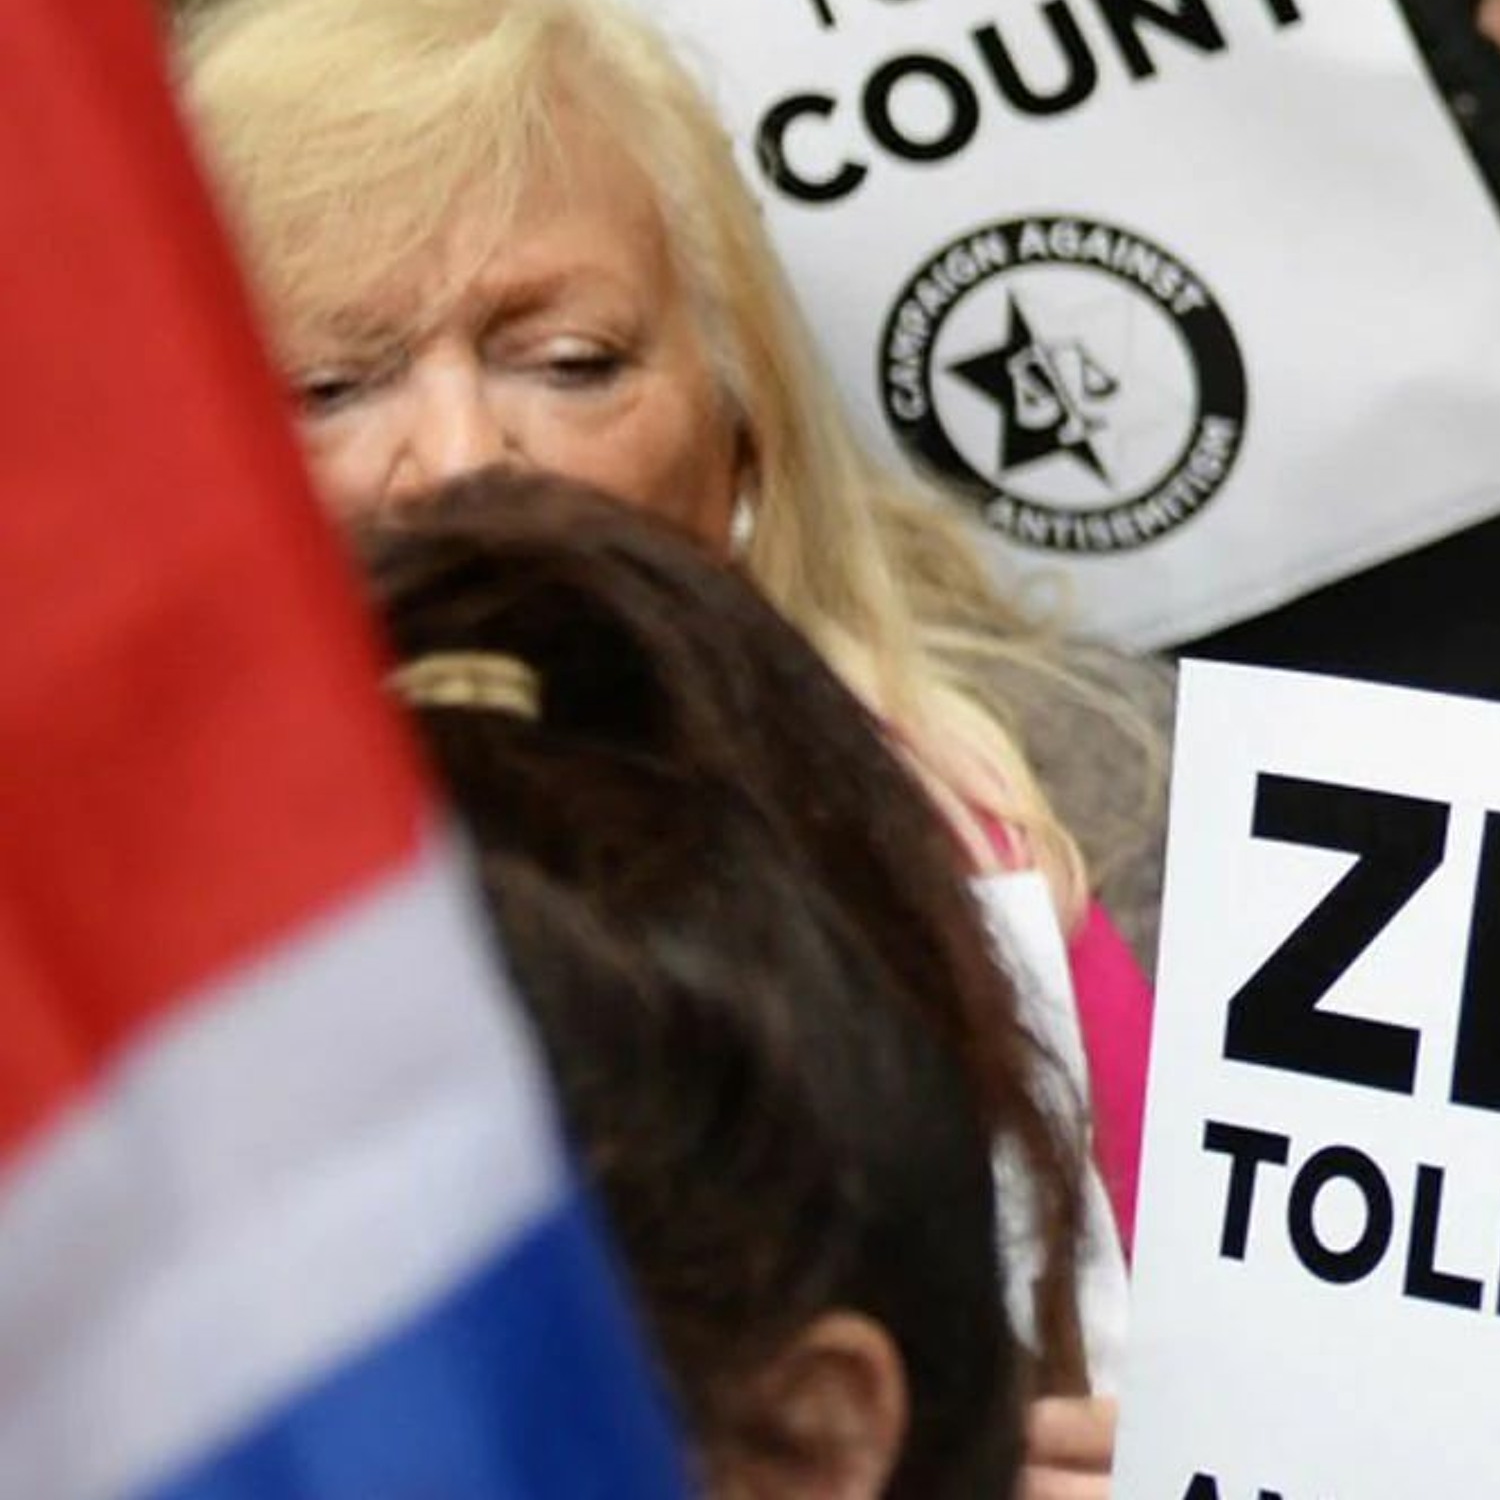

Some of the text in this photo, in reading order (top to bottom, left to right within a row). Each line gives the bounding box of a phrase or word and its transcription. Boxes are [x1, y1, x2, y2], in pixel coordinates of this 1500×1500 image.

[889, 218, 1208, 421] CAMPAIGN AGAINST
[984, 414, 1238, 550] ANTISEMITISM
